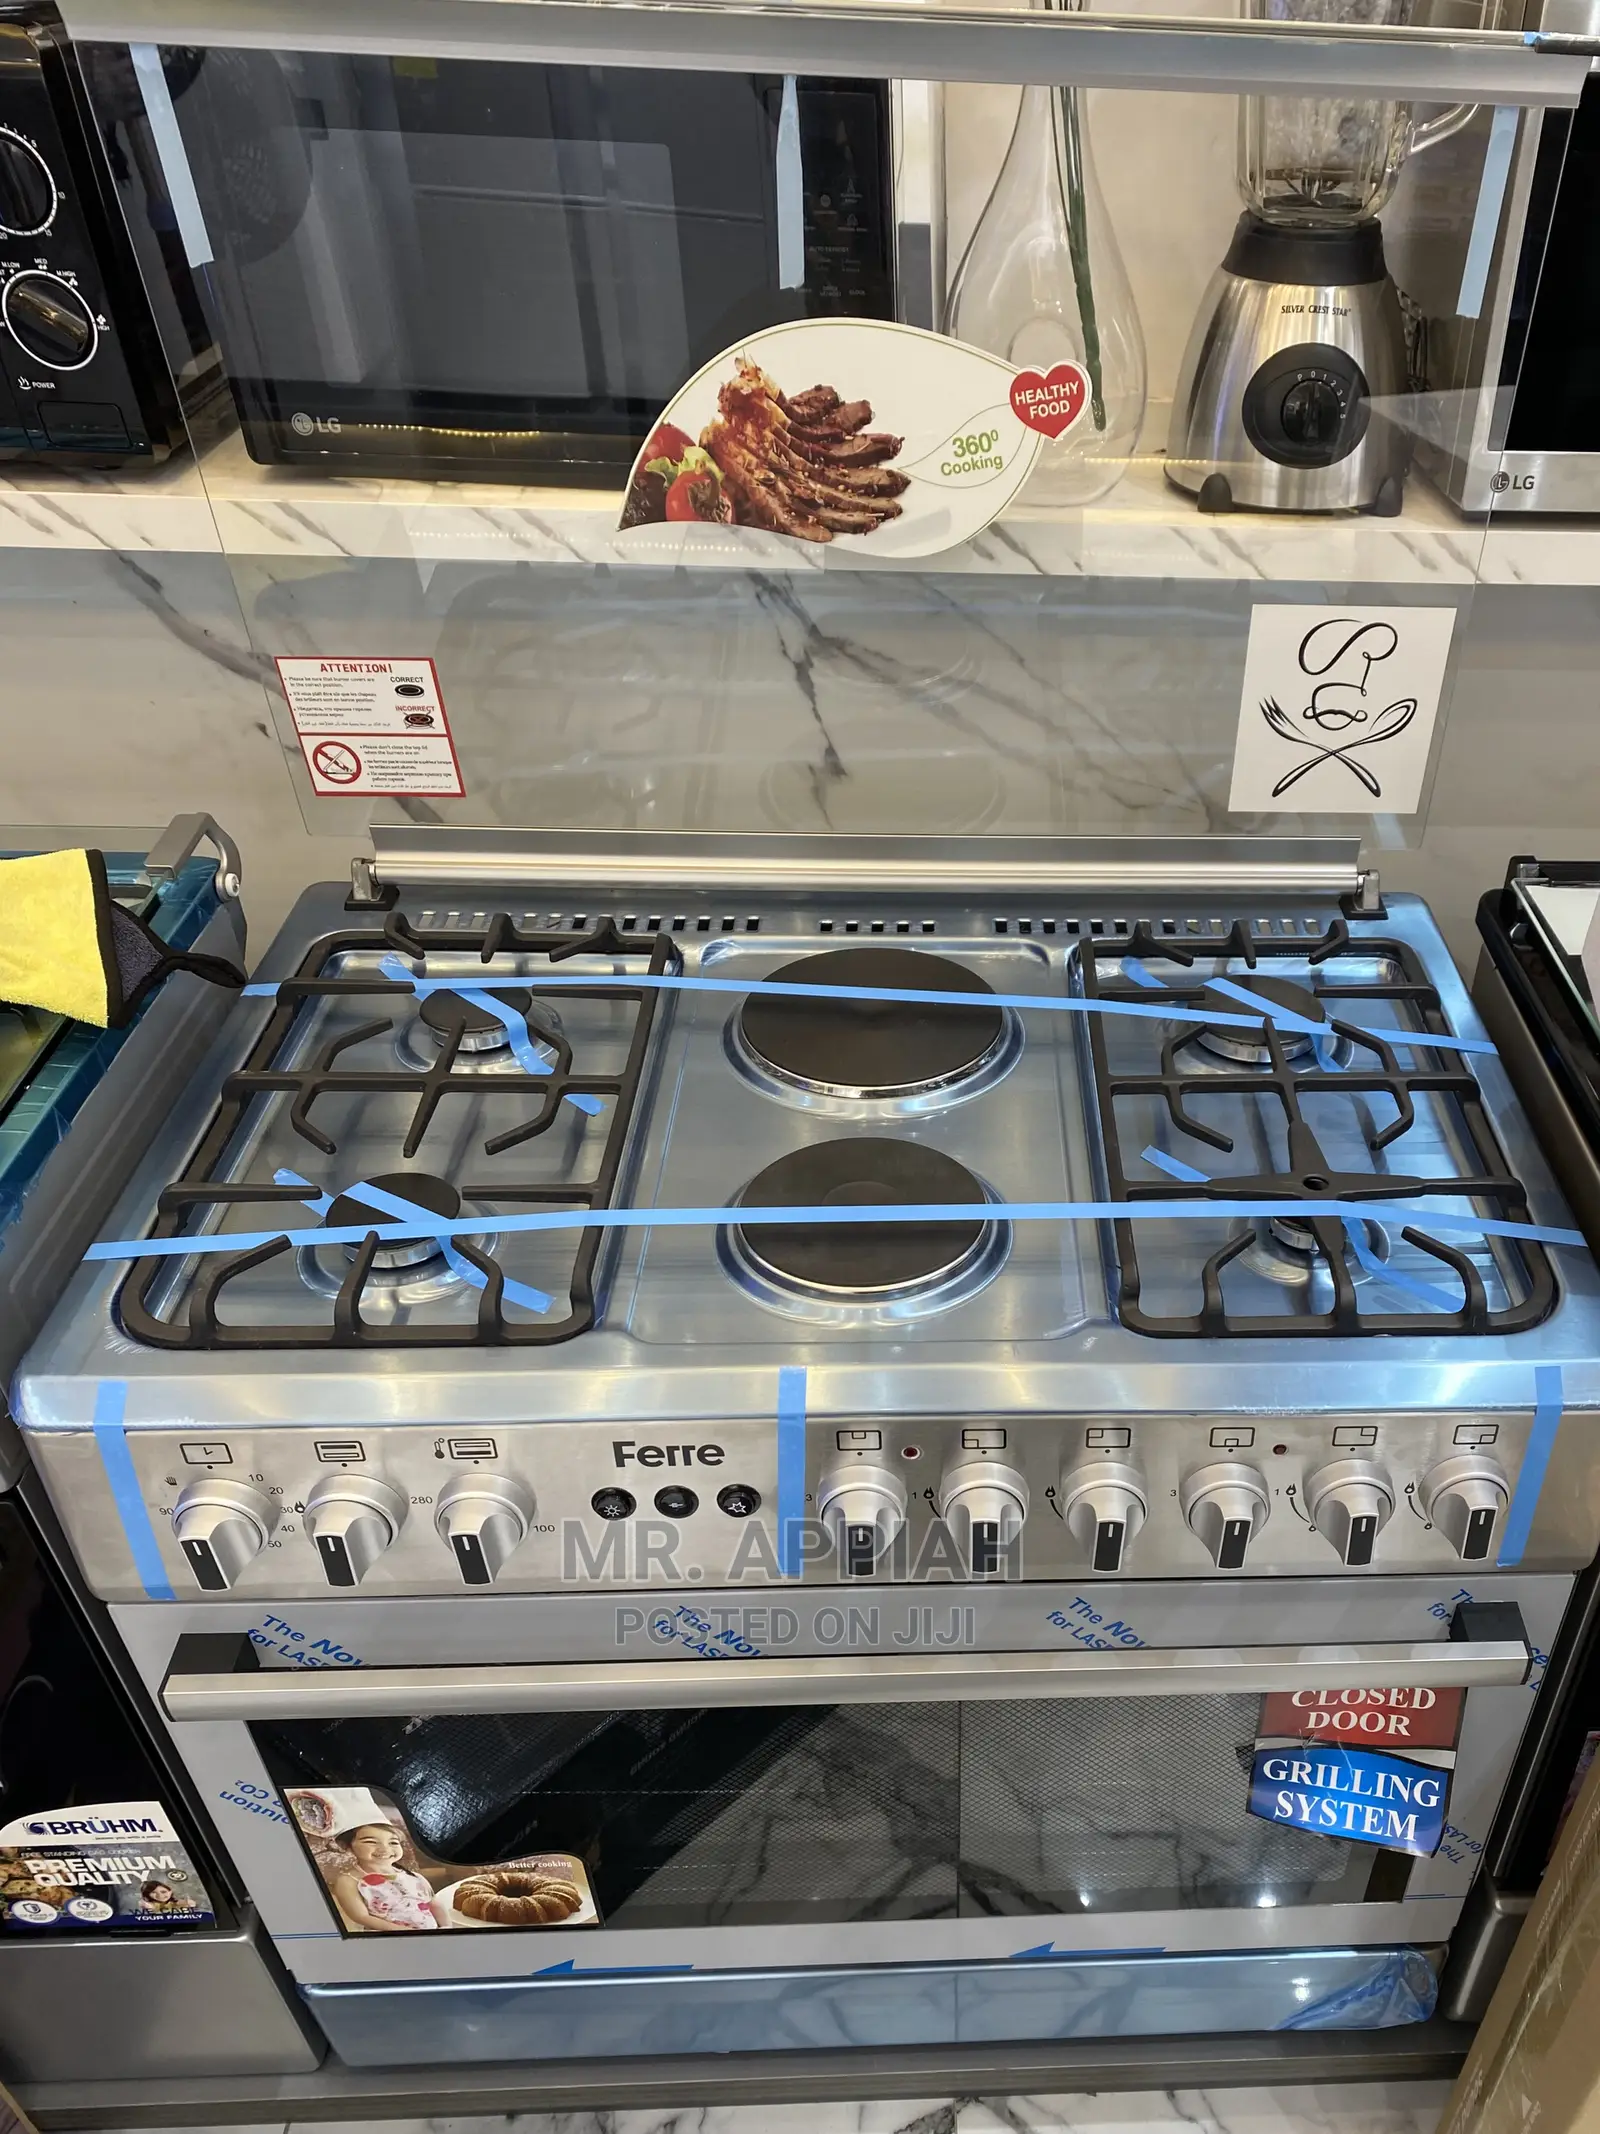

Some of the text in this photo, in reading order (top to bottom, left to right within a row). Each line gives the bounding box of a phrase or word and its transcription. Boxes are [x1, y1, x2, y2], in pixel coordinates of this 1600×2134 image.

[57, 191, 66, 200] 10
[1281, 305, 1304, 314] SILVER
[1308, 305, 1330, 314] CREST
[32, 381, 56, 390] POWER
[1014, 380, 1080, 406] HEALTHY
[1029, 400, 1071, 420] FOOD
[316, 416, 342, 434] LG
[940, 455, 1003, 476] Cooking
[1512, 474, 1535, 490] LG
[320, 663, 392, 674] ATTENTION!
[612, 1440, 726, 1468] Ferre
[249, 1474, 264, 1482] 10
[268, 1486, 284, 1495] 20
[804, 1494, 812, 1502] 3
[1170, 1489, 1177, 1497] 3
[410, 1496, 433, 1504] 280
[159, 1507, 174, 1516] 90
[280, 1506, 294, 1514] 30
[534, 1525, 556, 1533] 100
[268, 1540, 282, 1548] 50
[674, 1605, 712, 1633] The
[1068, 1596, 1103, 1624] The
[1427, 1602, 1452, 1620] for
[262, 1614, 305, 1642] The
[1046, 1610, 1074, 1630] for
[248, 1628, 278, 1648] for
[652, 1620, 684, 1640] for
[1292, 1688, 1436, 1710] CLOSED
[1305, 1710, 1412, 1737] DOOR
[1262, 1758, 1441, 1808] GRILLING
[220, 1791, 290, 1824] olution
[1274, 1790, 1420, 1842] SYSTEM
[49, 1816, 158, 1836] BRÜHM
[1445, 1824, 1468, 1843] LAS
[1440, 1844, 1465, 1864] The
[24, 1856, 176, 1874] PREMIUM
[538, 1860, 572, 1868] cooking
[34, 1870, 150, 1887] QUALITY
[135, 1914, 164, 1922] YOUR
